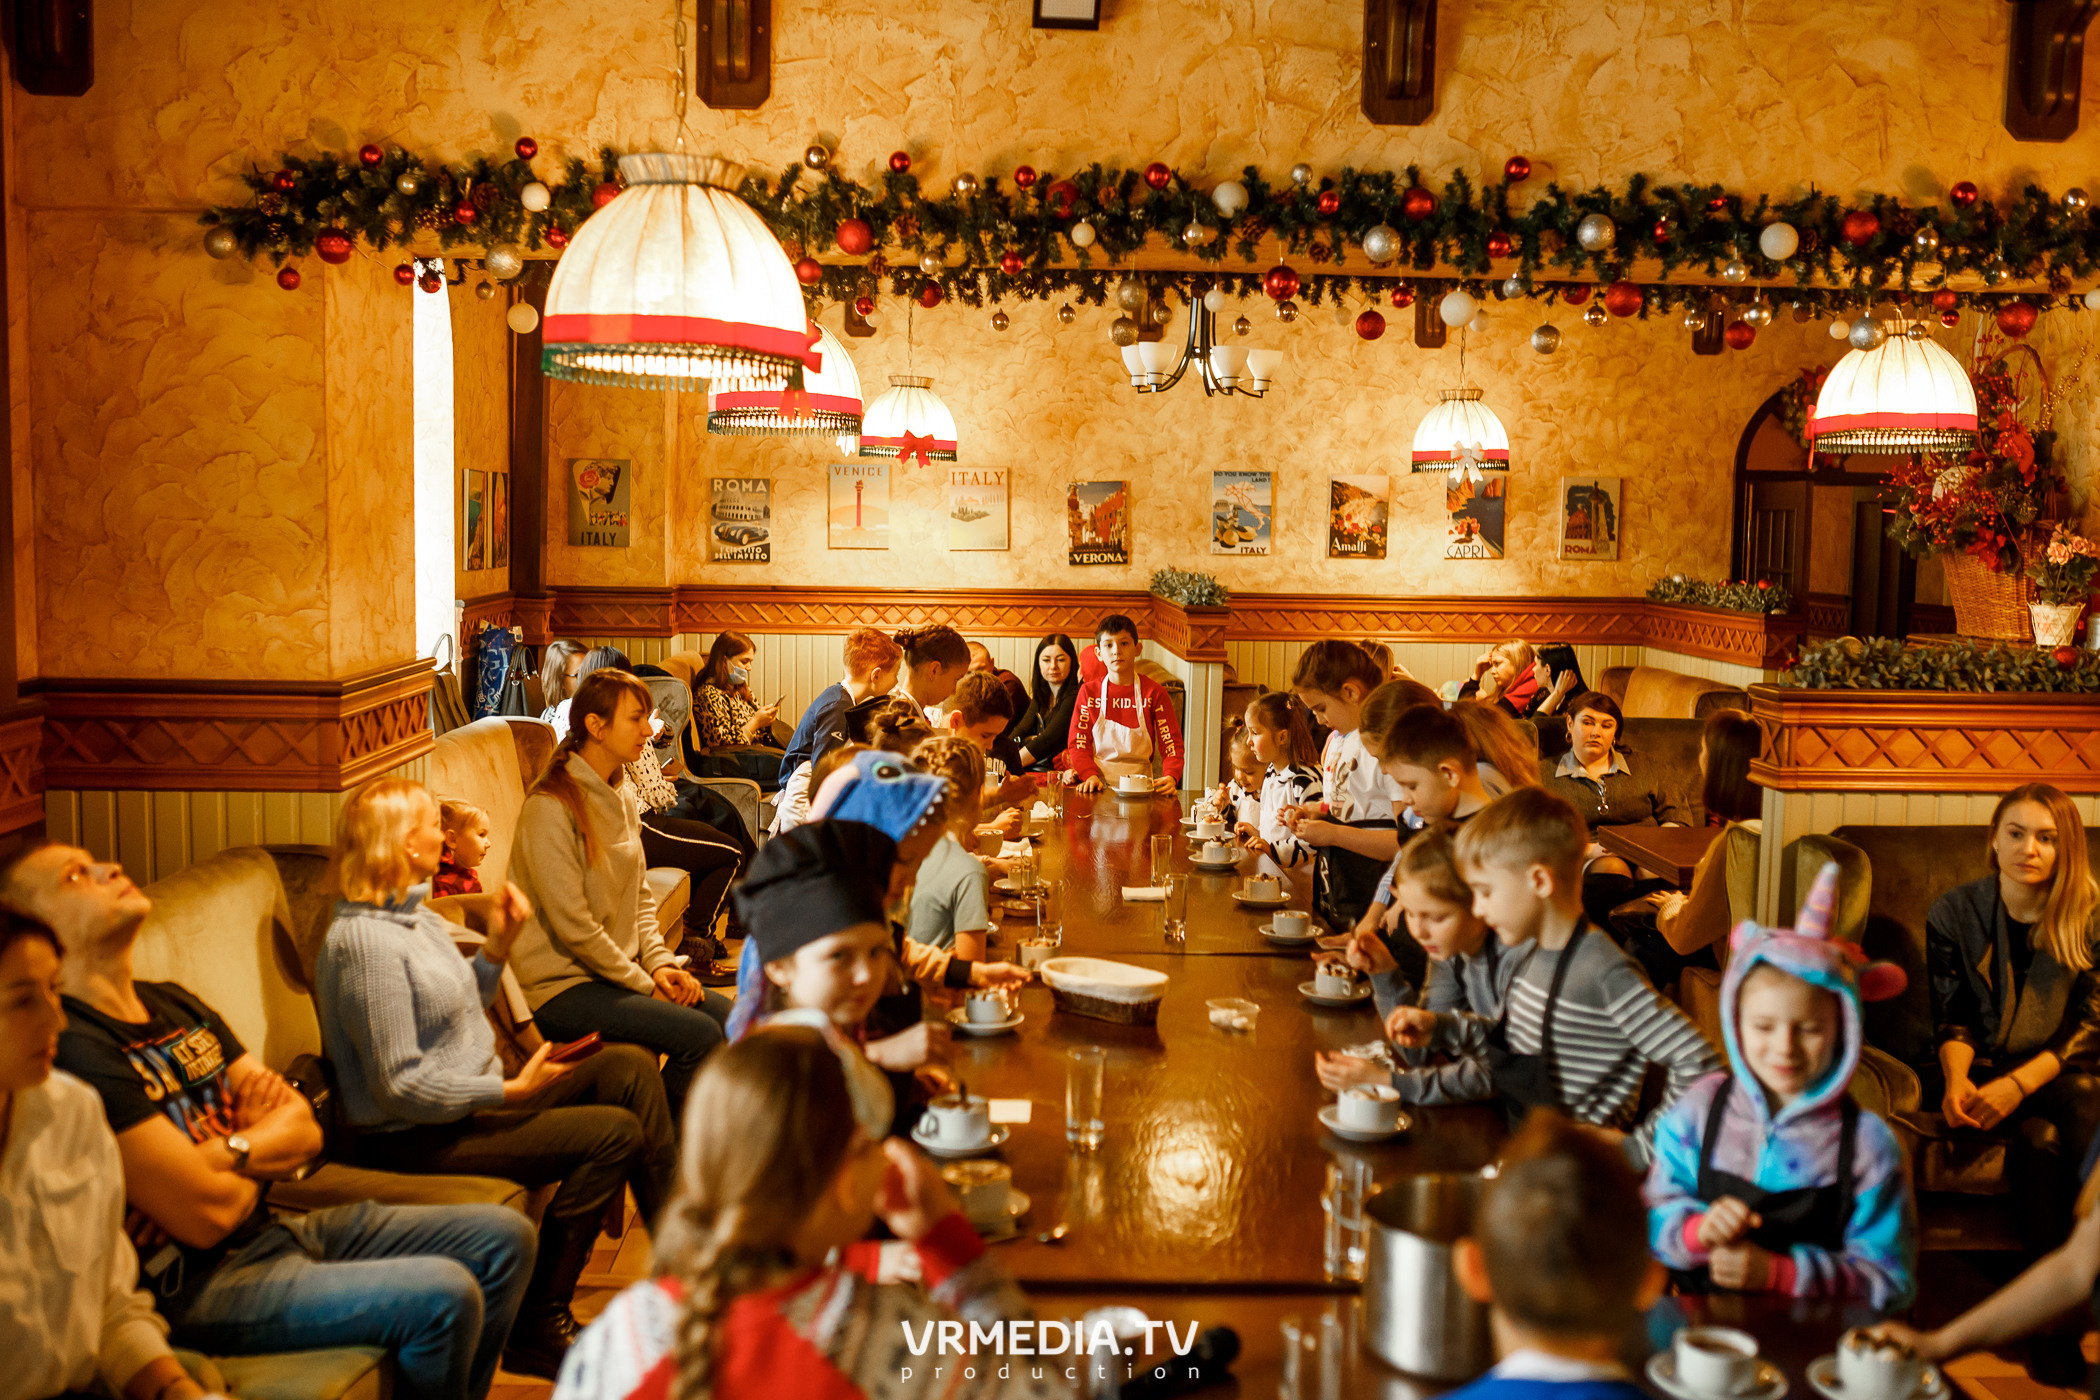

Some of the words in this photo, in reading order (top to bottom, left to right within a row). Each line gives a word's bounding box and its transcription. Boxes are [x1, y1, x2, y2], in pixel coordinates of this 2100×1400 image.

[834, 466, 883, 476] VENICE
[951, 471, 1005, 486] ITALY
[714, 480, 767, 492] ROMA
[580, 532, 616, 546] ITALY
[1447, 545, 1484, 558] CAPRI
[1565, 544, 1597, 554] ROMA
[1074, 553, 1123, 563] VERONA
